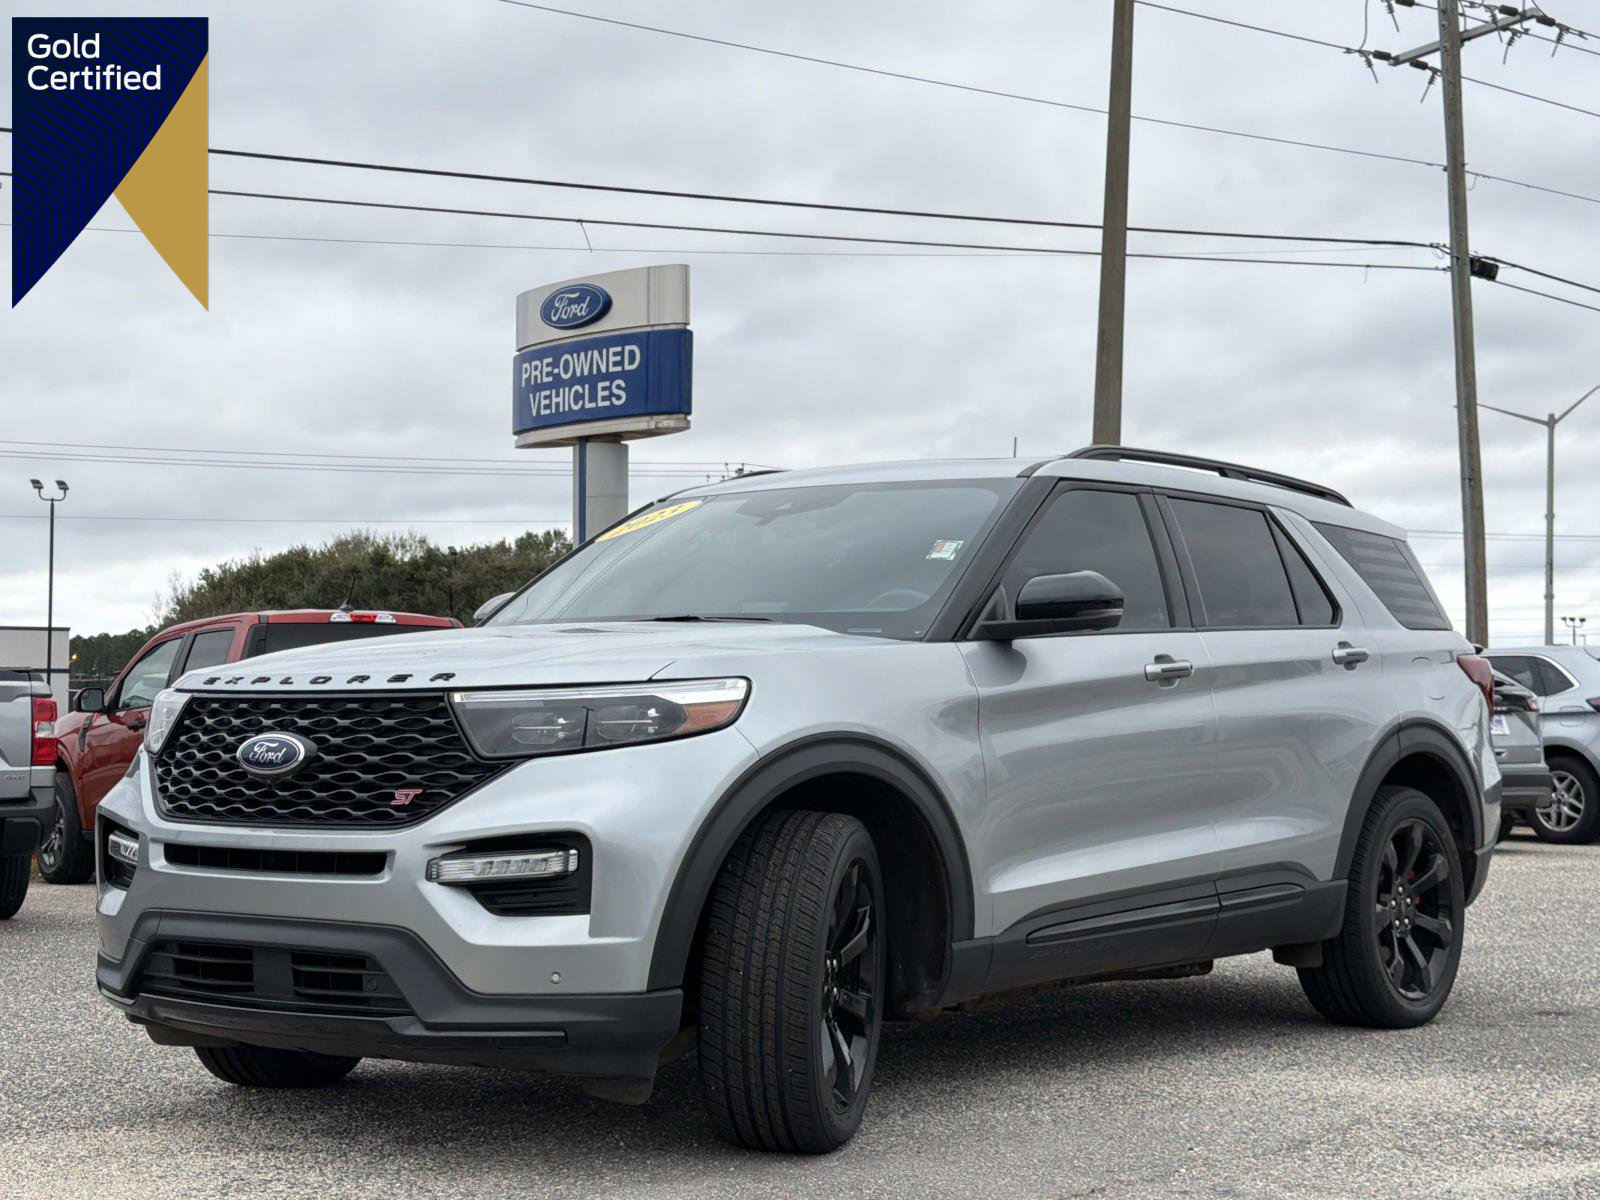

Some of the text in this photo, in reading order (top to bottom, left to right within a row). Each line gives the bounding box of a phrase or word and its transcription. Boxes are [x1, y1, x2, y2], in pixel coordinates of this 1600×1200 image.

[551, 291, 591, 321] Ford
[521, 344, 641, 388] PRE-OWNED
[530, 379, 627, 417] VEHICLES
[203, 672, 456, 685] EXPLORER
[249, 741, 287, 764] Ford
[391, 789, 422, 805] ST
